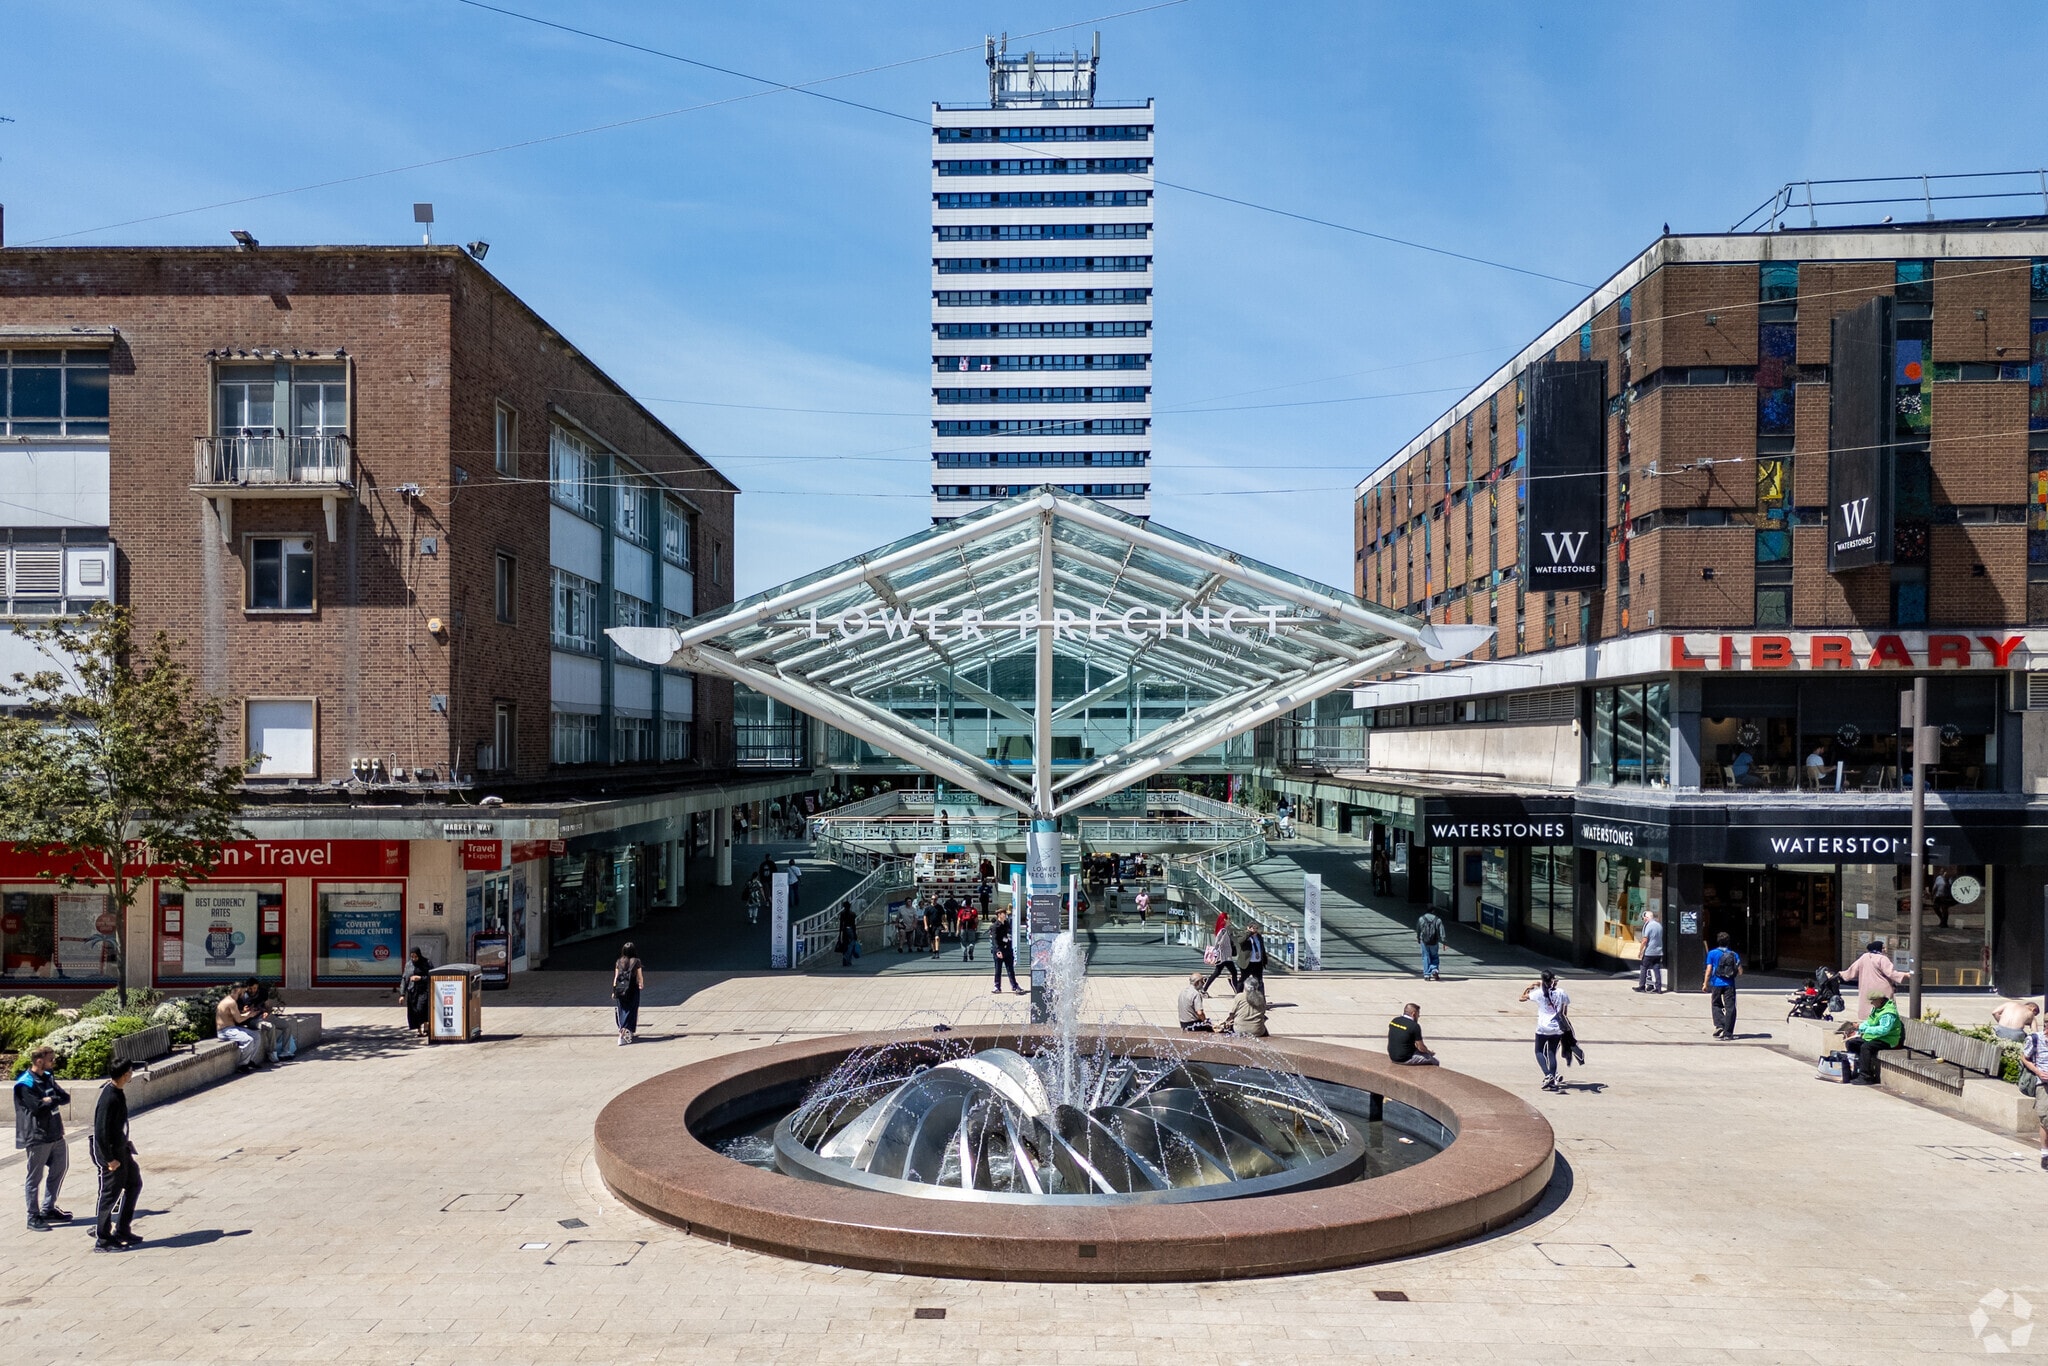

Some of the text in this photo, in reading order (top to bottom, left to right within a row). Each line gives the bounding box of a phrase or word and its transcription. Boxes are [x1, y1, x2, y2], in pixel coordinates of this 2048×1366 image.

[1841, 497, 1869, 537] W
[1541, 532, 1589, 563] W
[1837, 536, 1873, 551] WATERSTONES
[1535, 565, 1596, 573] WATERSTONES
[810, 605, 1287, 641] LOWER PRECINCT
[1671, 635, 2026, 669] LIBRARY
[476, 823, 492, 831] WAY
[1432, 823, 1565, 838] WATERSTONES
[1583, 824, 1634, 847] WATERSTONES
[468, 843, 496, 852] Travel
[1771, 837, 1936, 853] WATERSTONS
[255, 842, 332, 865] Travel
[1960, 885, 1971, 895] W
[195, 897, 246, 907] BEST CURRENCY
[211, 908, 231, 917] RATES
